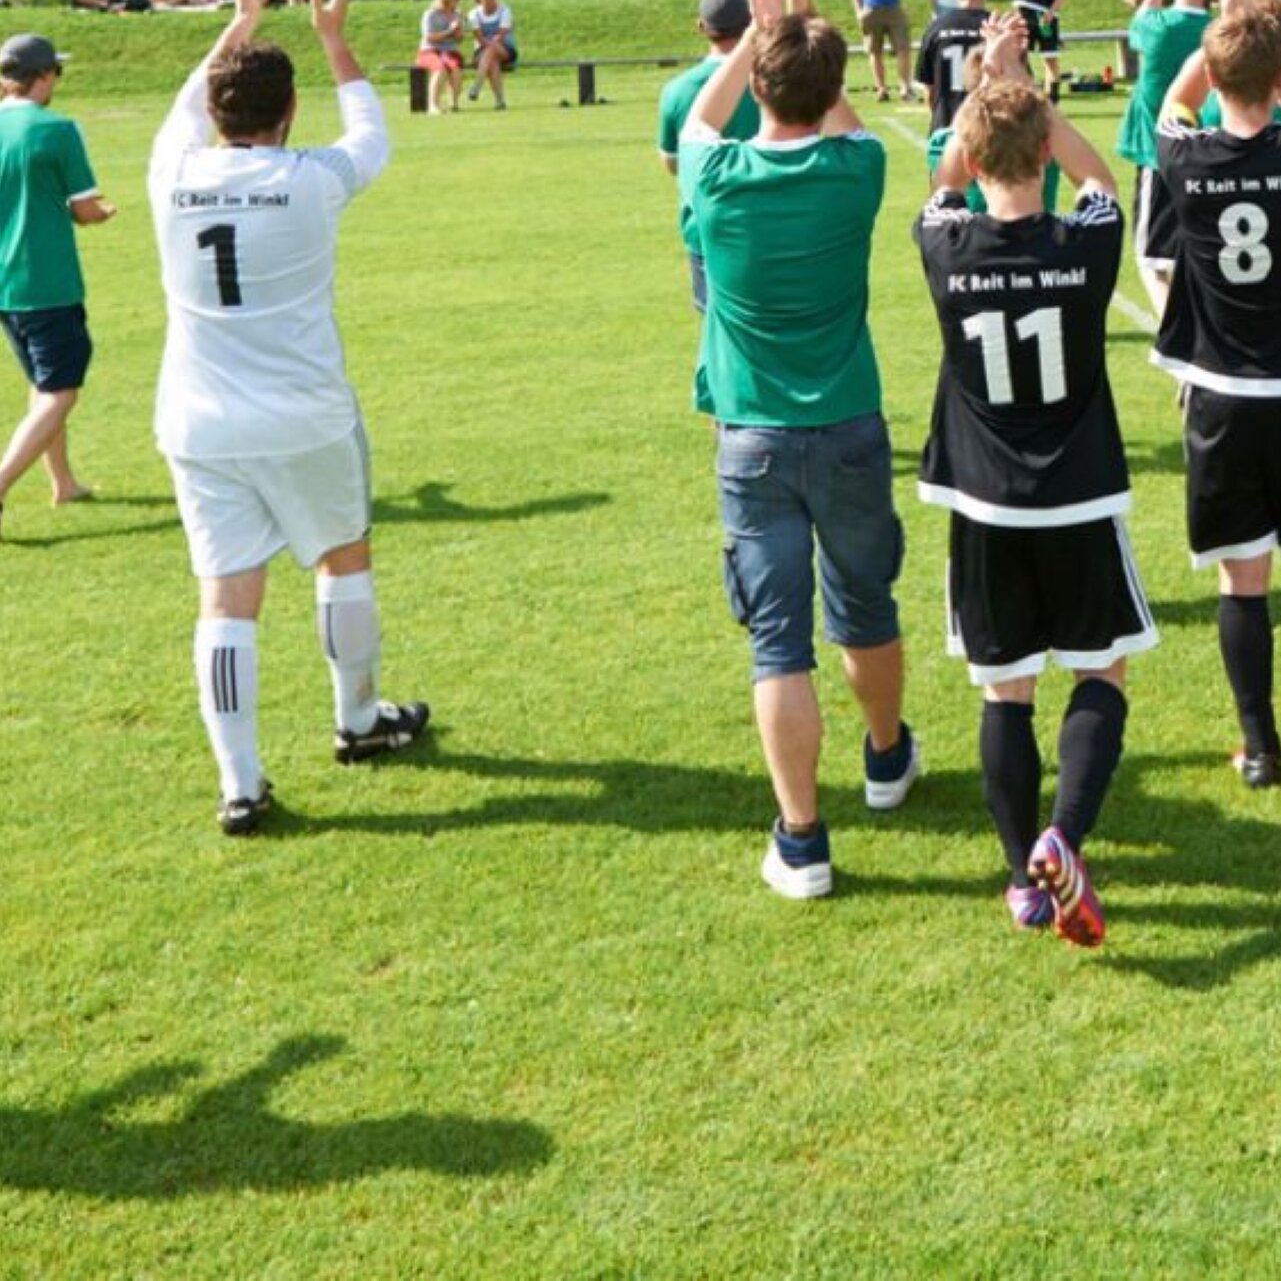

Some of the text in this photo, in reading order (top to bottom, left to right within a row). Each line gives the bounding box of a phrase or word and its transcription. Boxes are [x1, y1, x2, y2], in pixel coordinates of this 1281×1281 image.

[943, 45, 965, 92] 1
[1206, 178, 1236, 193] Reit
[1241, 178, 1261, 191] im
[197, 224, 242, 306] 1
[1218, 202, 1272, 285] 8
[971, 272, 1004, 292] Reit
[1011, 272, 1033, 289] im
[1038, 267, 1086, 289] Winkl
[961, 306, 1067, 404] 11
